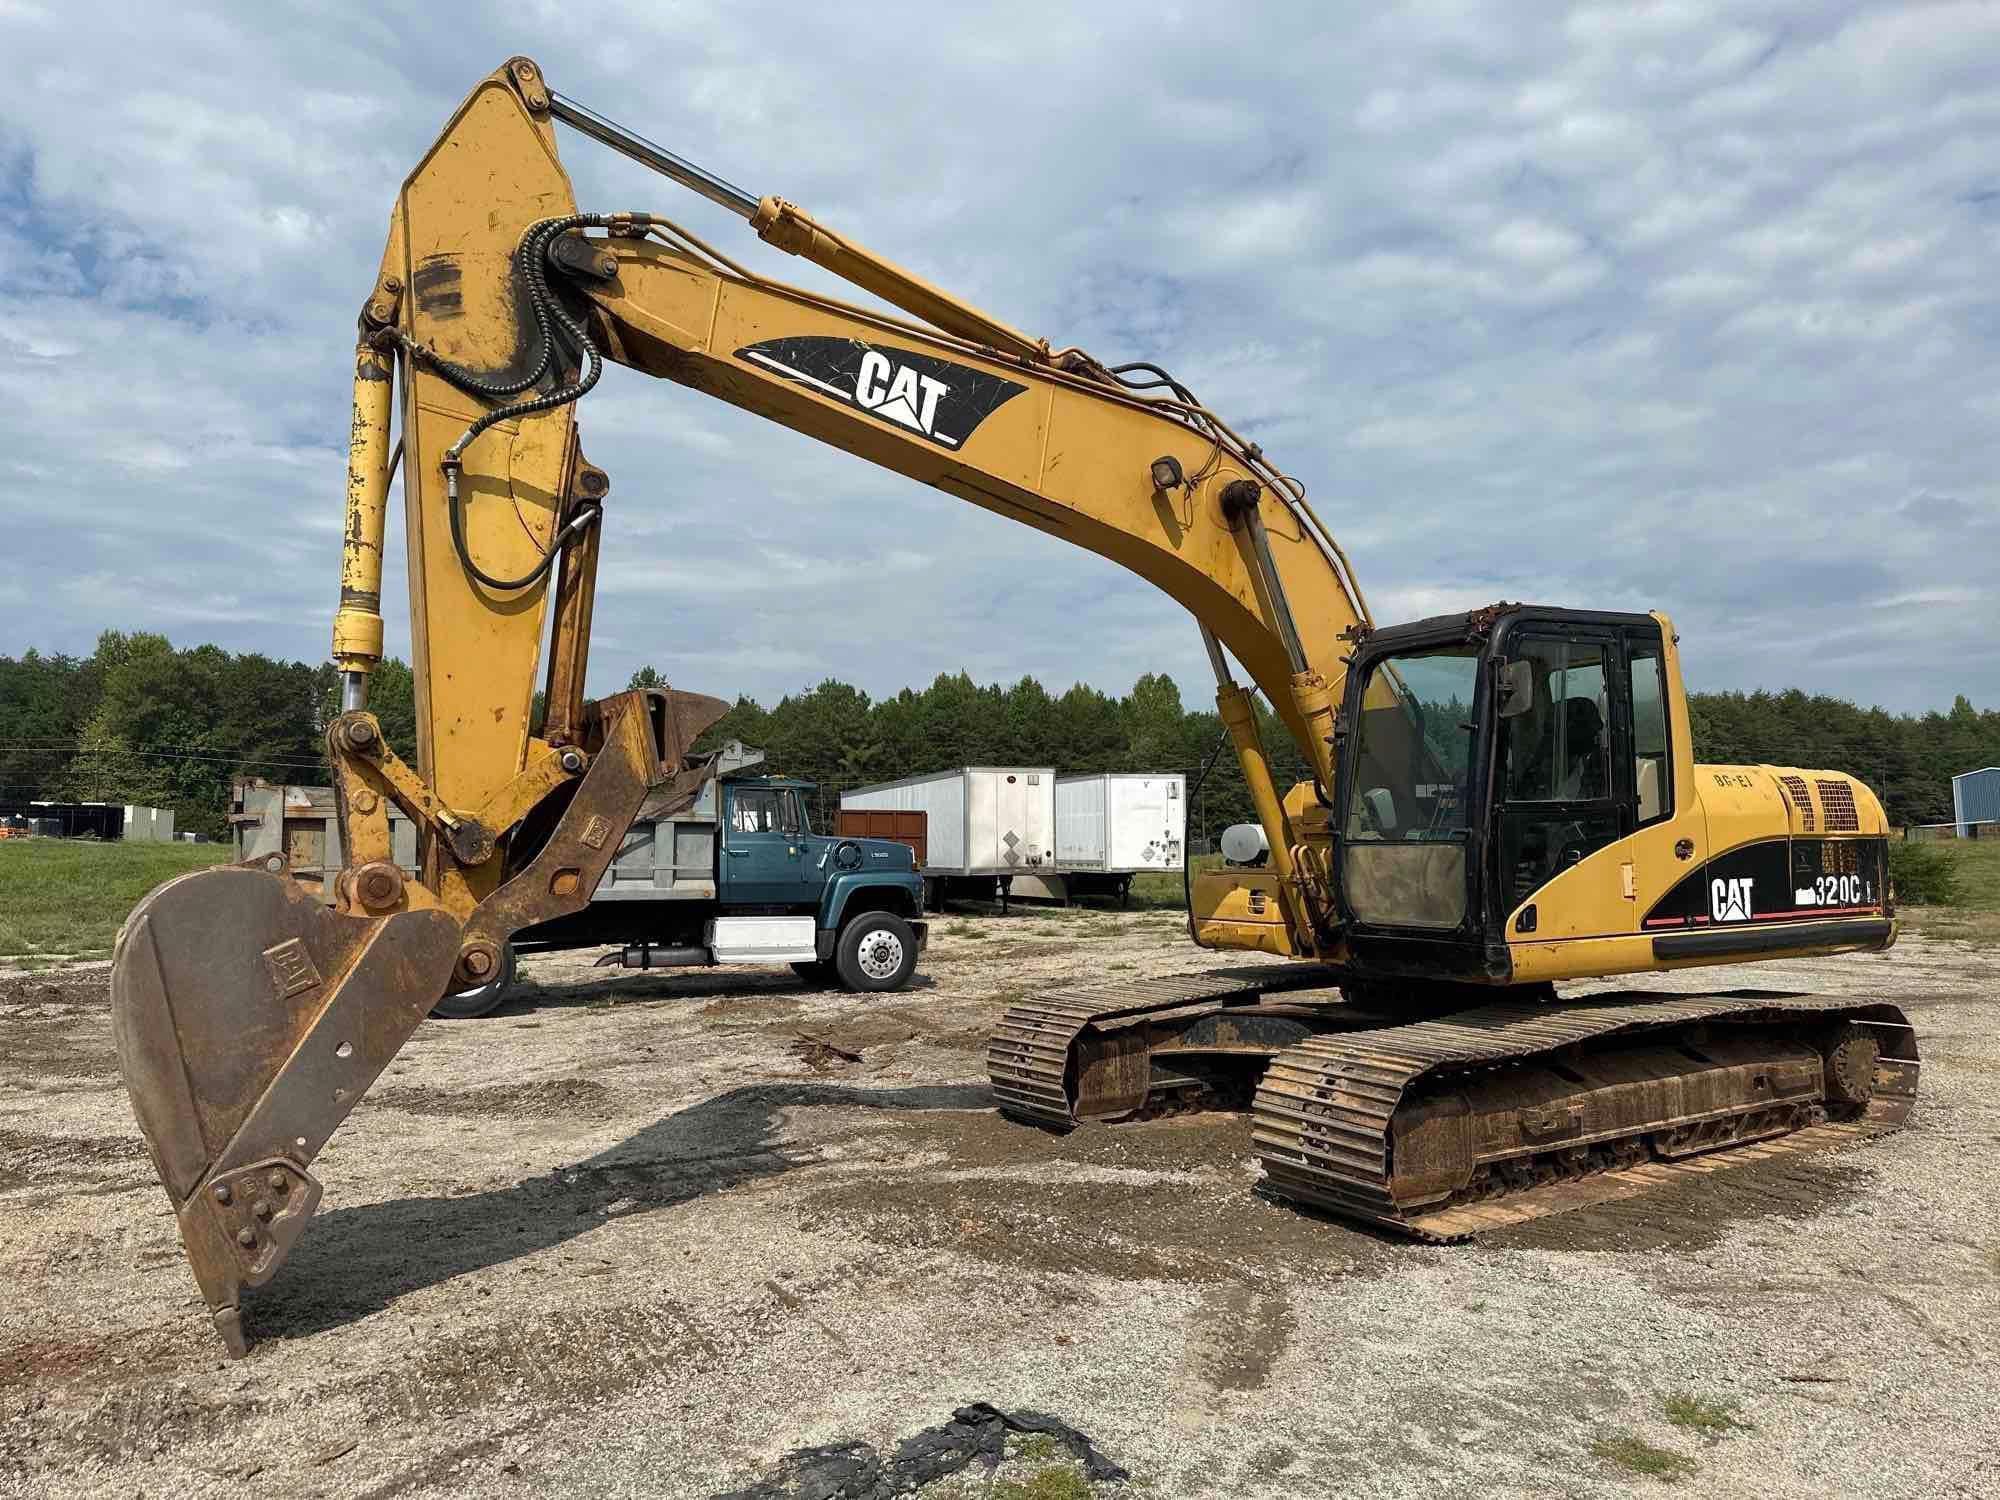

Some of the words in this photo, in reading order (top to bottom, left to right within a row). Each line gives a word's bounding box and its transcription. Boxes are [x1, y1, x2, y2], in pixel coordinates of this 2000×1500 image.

[856, 351, 947, 435] CAT
[1711, 878, 1753, 921] CAT
[1816, 875, 1860, 905] 320C
